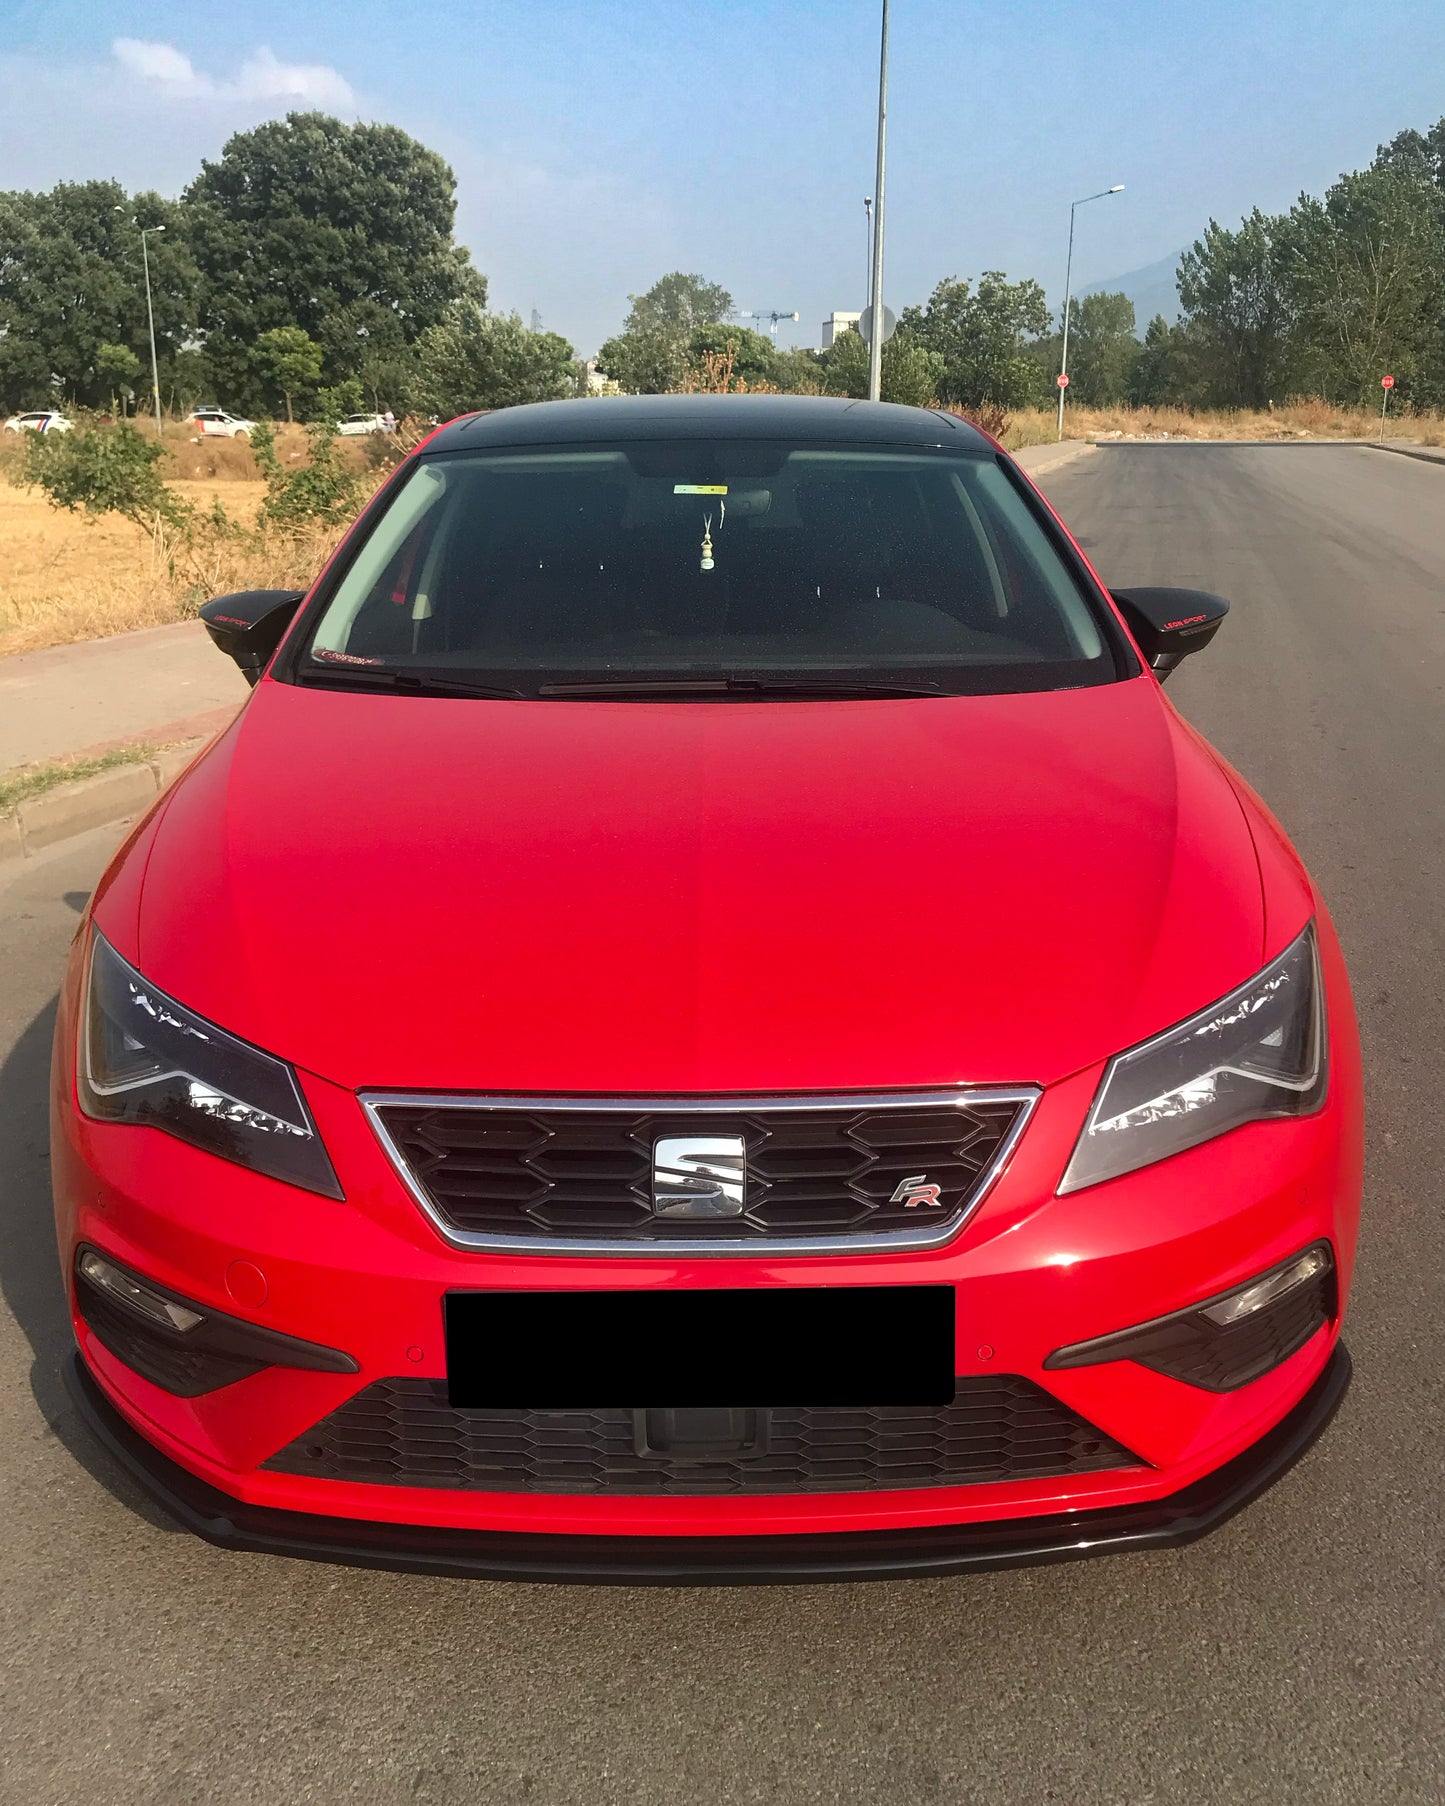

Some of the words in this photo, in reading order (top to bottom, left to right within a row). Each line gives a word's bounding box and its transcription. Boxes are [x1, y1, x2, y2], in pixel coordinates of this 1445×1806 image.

[1163, 620, 1184, 629] LEON
[1183, 614, 1207, 624] SPORT
[889, 1174, 942, 1208] FR
